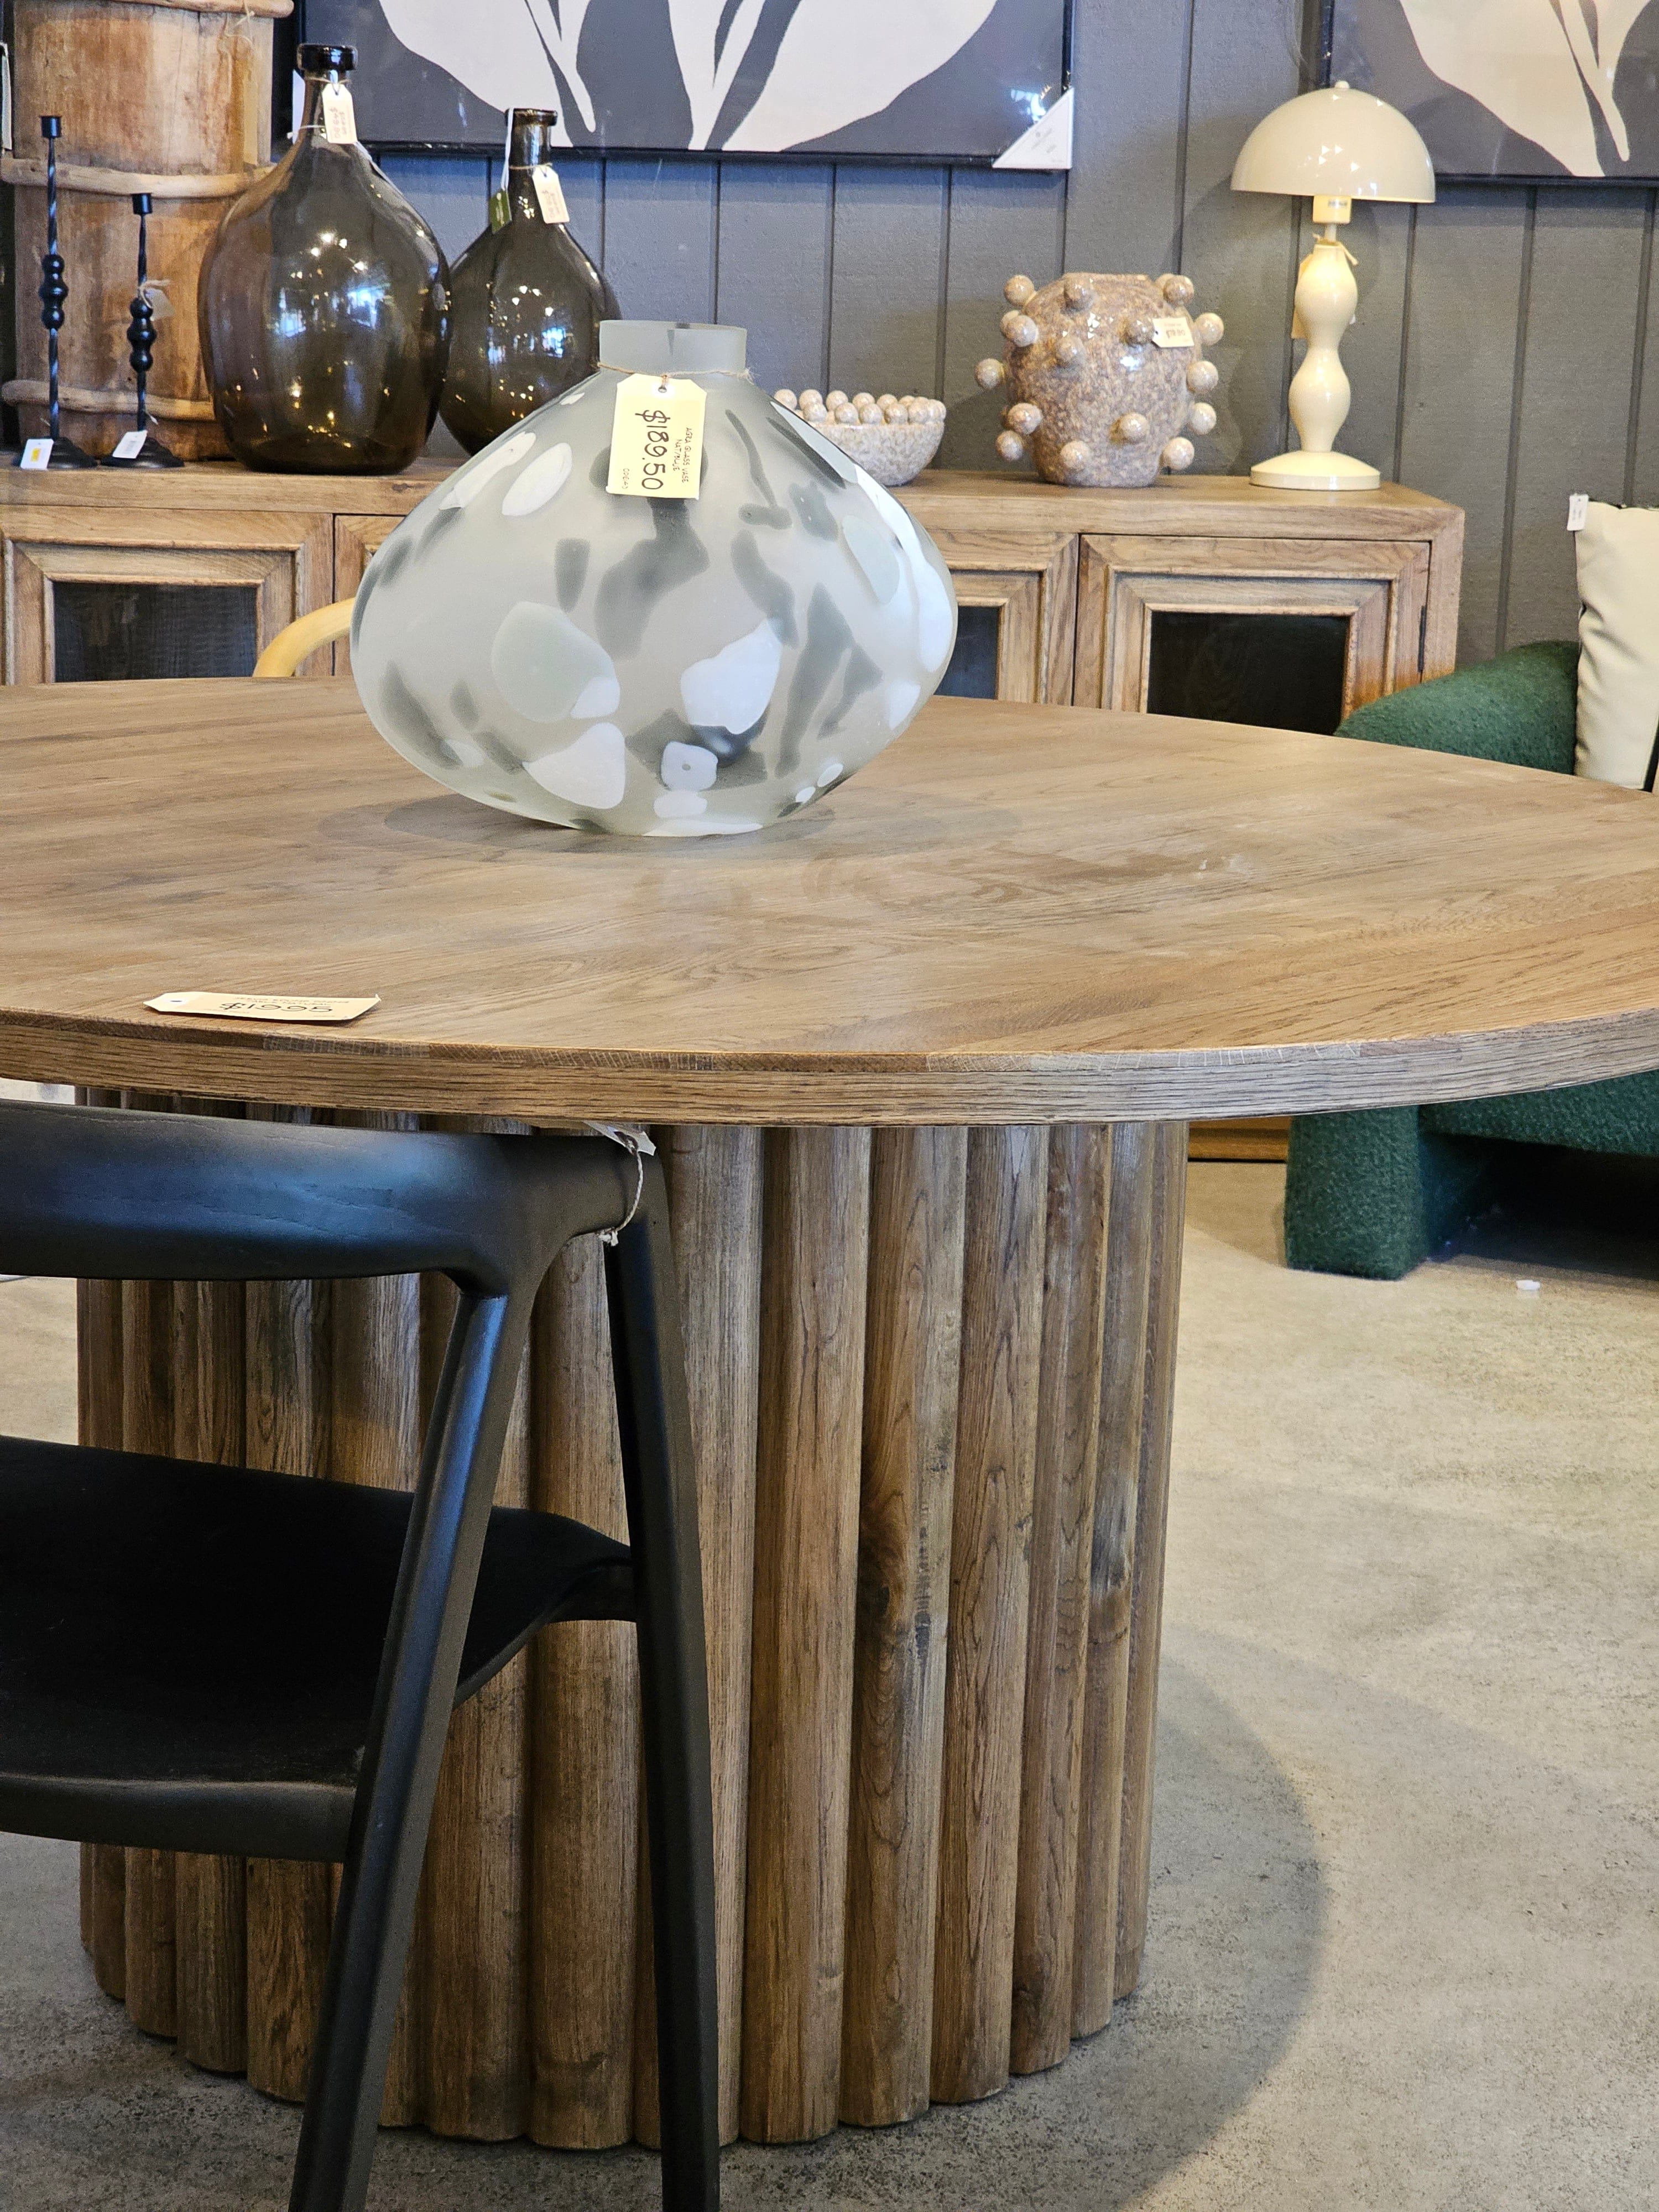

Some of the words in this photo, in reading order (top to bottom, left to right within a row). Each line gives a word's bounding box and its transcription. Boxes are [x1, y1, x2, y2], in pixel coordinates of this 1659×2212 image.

[635, 410, 671, 491] $189.50
[683, 445, 692, 466] GLASS
[682, 468, 690, 483] VASE
[220, 1002, 333, 1012] $1995
